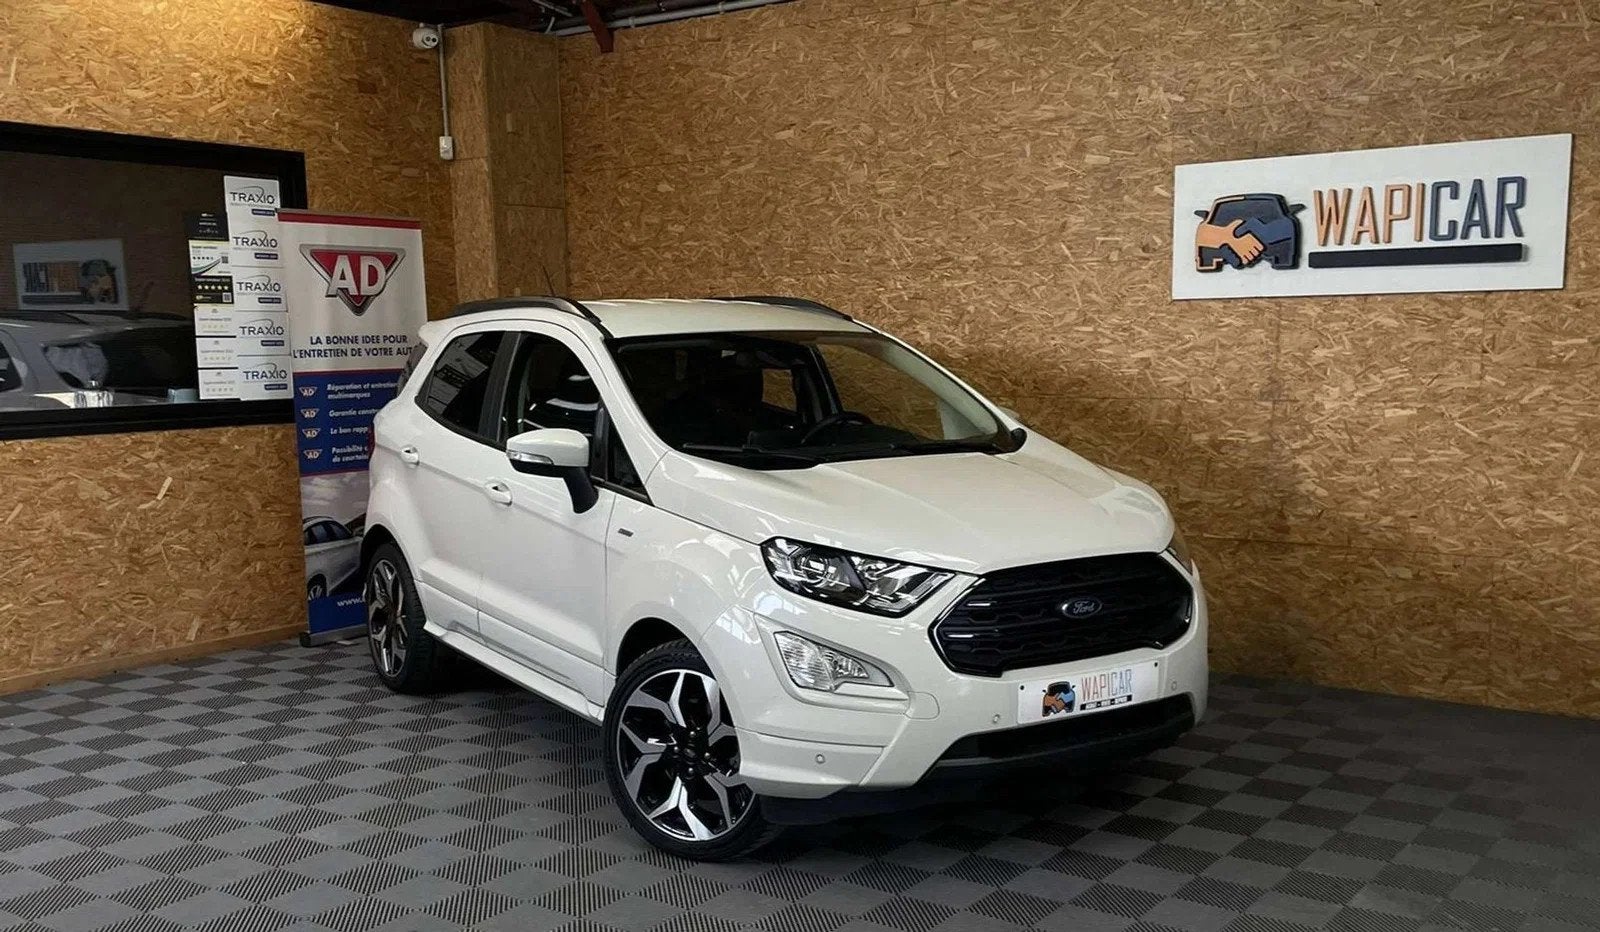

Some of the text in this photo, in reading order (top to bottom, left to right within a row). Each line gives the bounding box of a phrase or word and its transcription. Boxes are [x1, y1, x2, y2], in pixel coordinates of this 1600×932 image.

[230, 192, 275, 204] TRAXIO
[1312, 176, 1526, 247] WAPICAR
[232, 236, 278, 248] TRAXIO
[327, 255, 387, 297] AD
[236, 281, 281, 292] TRAXIO
[239, 325, 285, 335] TRAXIO
[310, 334, 407, 345] LA BONNE IDEE POUR
[293, 347, 413, 358] L'ENTRETIEN DE VOTRE AUT
[242, 370, 287, 380] TRAXIO
[1073, 601, 1095, 614] Ford
[1081, 669, 1132, 701] WAPICAR
